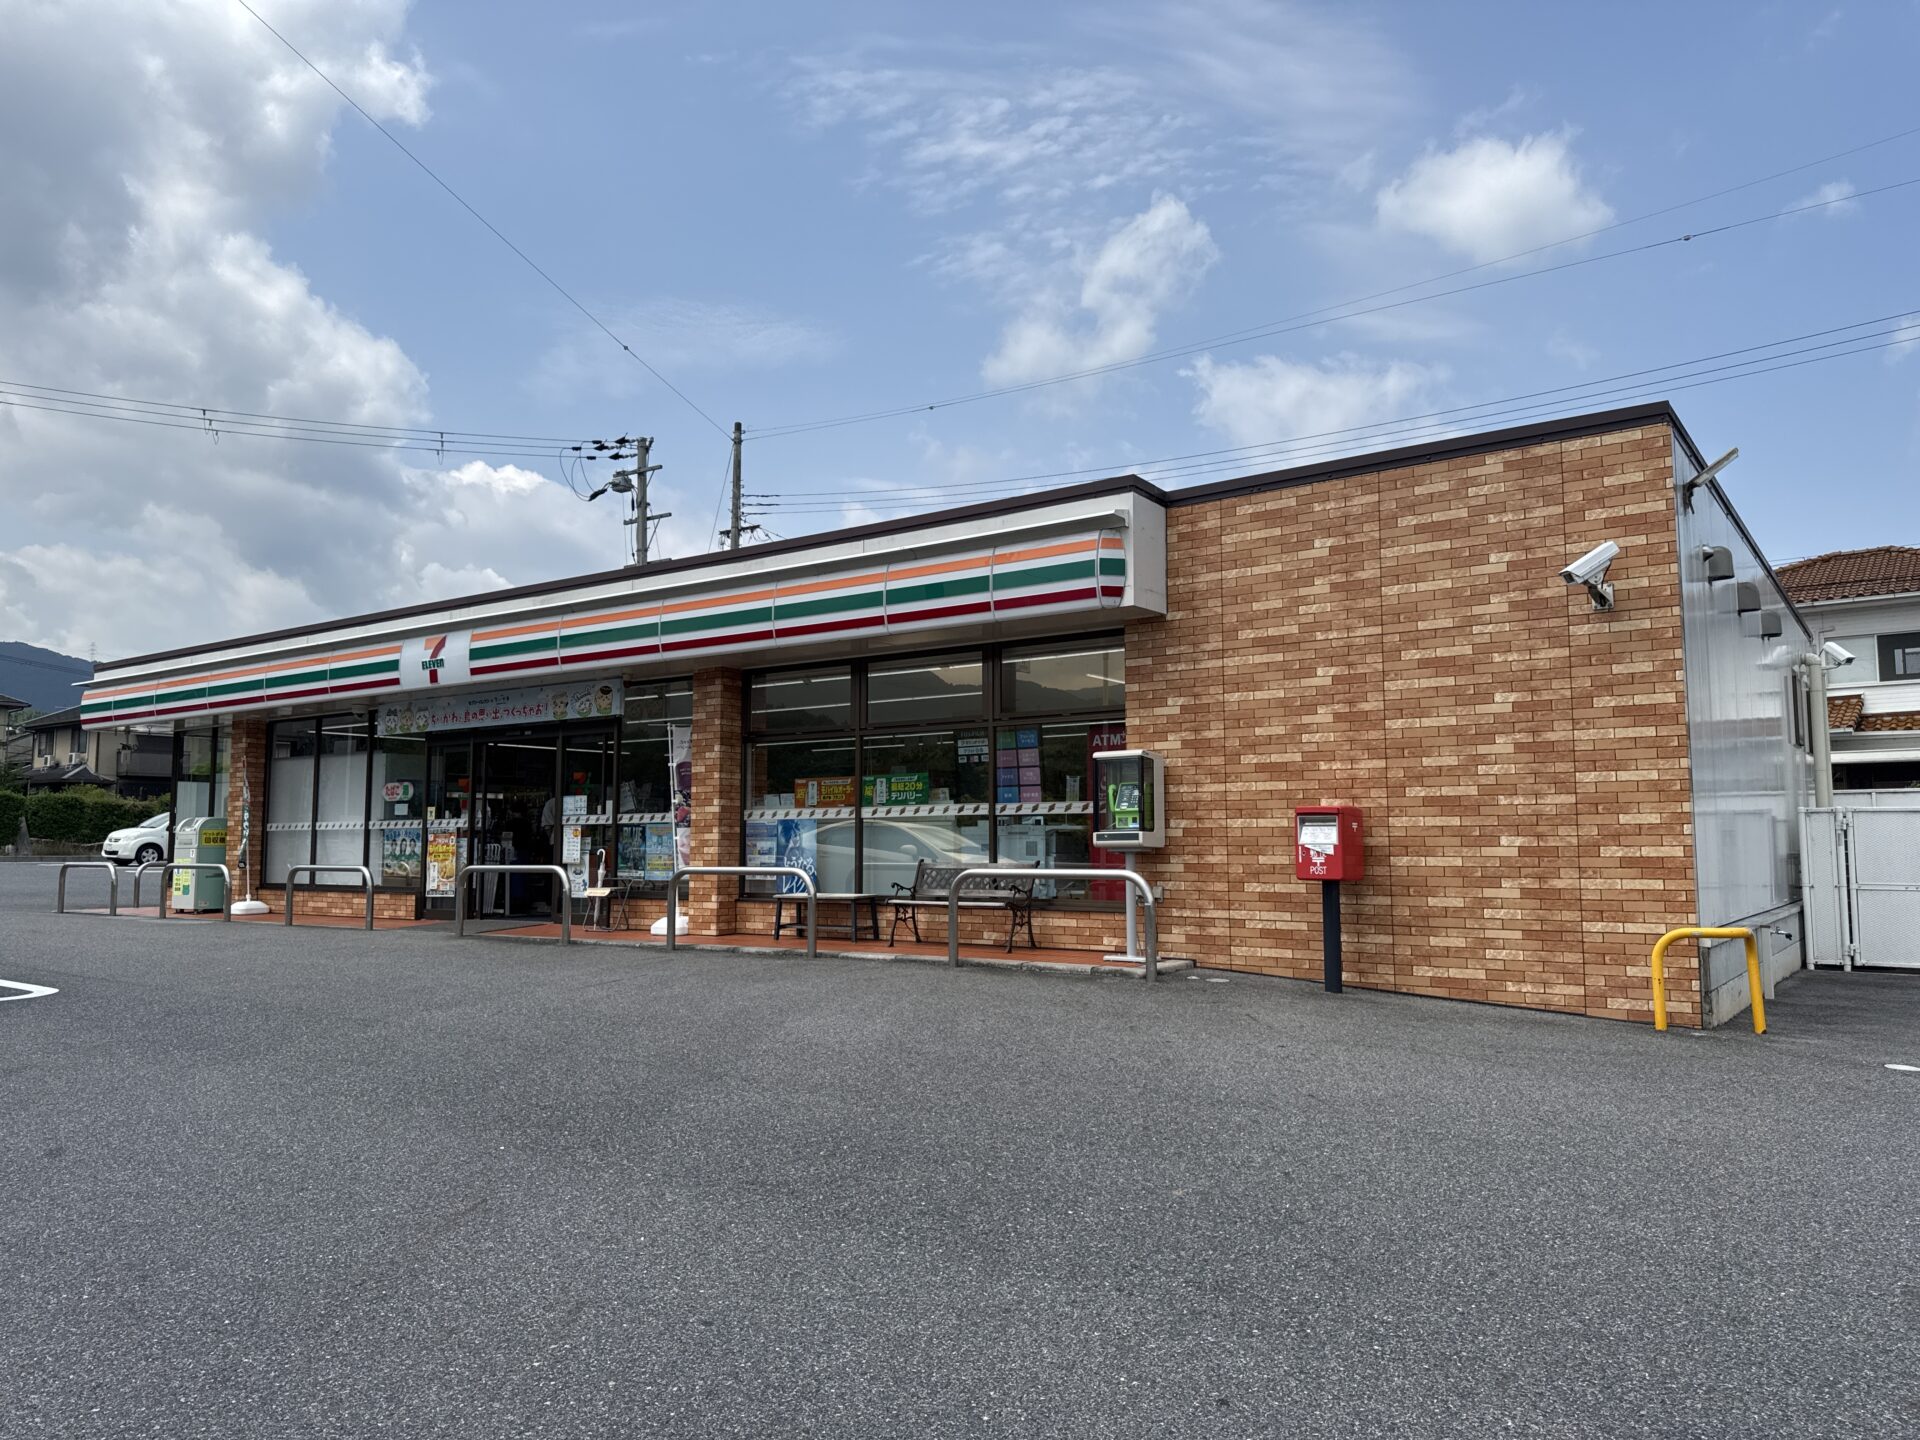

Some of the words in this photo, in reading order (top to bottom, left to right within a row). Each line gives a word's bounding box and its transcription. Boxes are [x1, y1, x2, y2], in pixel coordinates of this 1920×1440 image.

[424, 635, 447, 684] 7
[1092, 734, 1121, 747] ATM
[1310, 866, 1327, 875] POST
